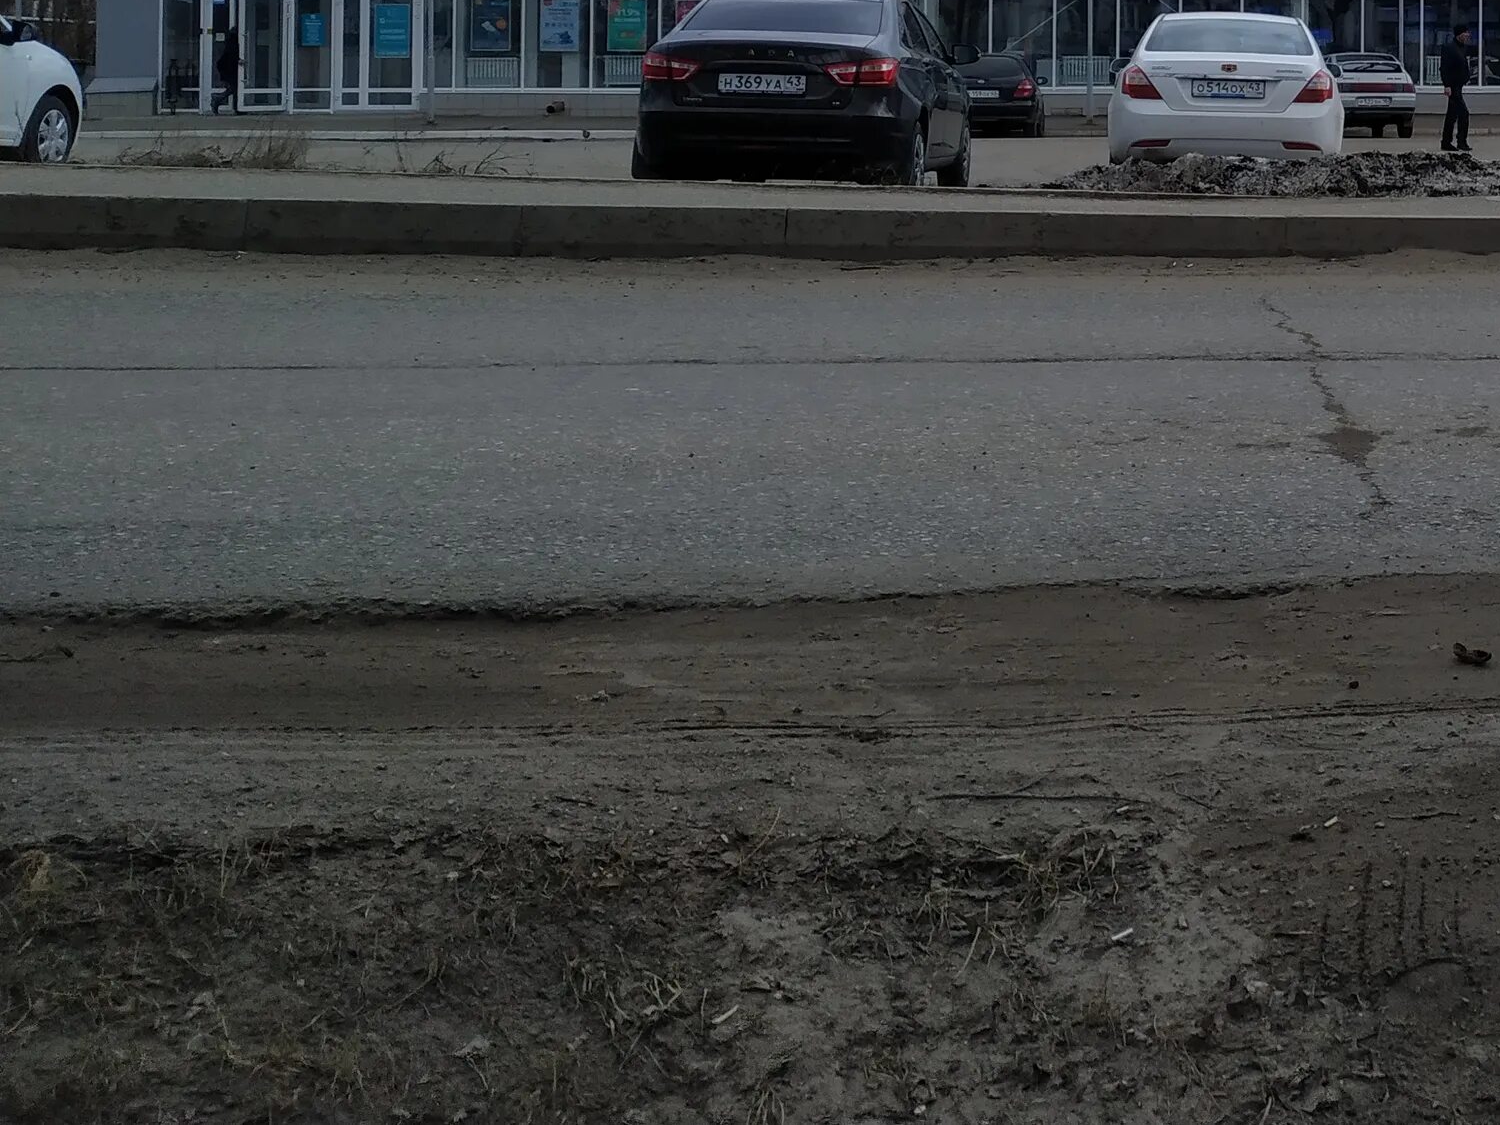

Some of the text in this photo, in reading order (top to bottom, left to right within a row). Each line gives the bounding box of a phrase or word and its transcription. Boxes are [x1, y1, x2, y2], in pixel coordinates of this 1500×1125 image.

[723, 76, 801, 90] Н369УА 43
[1196, 82, 1245, 93] О514ОХ
